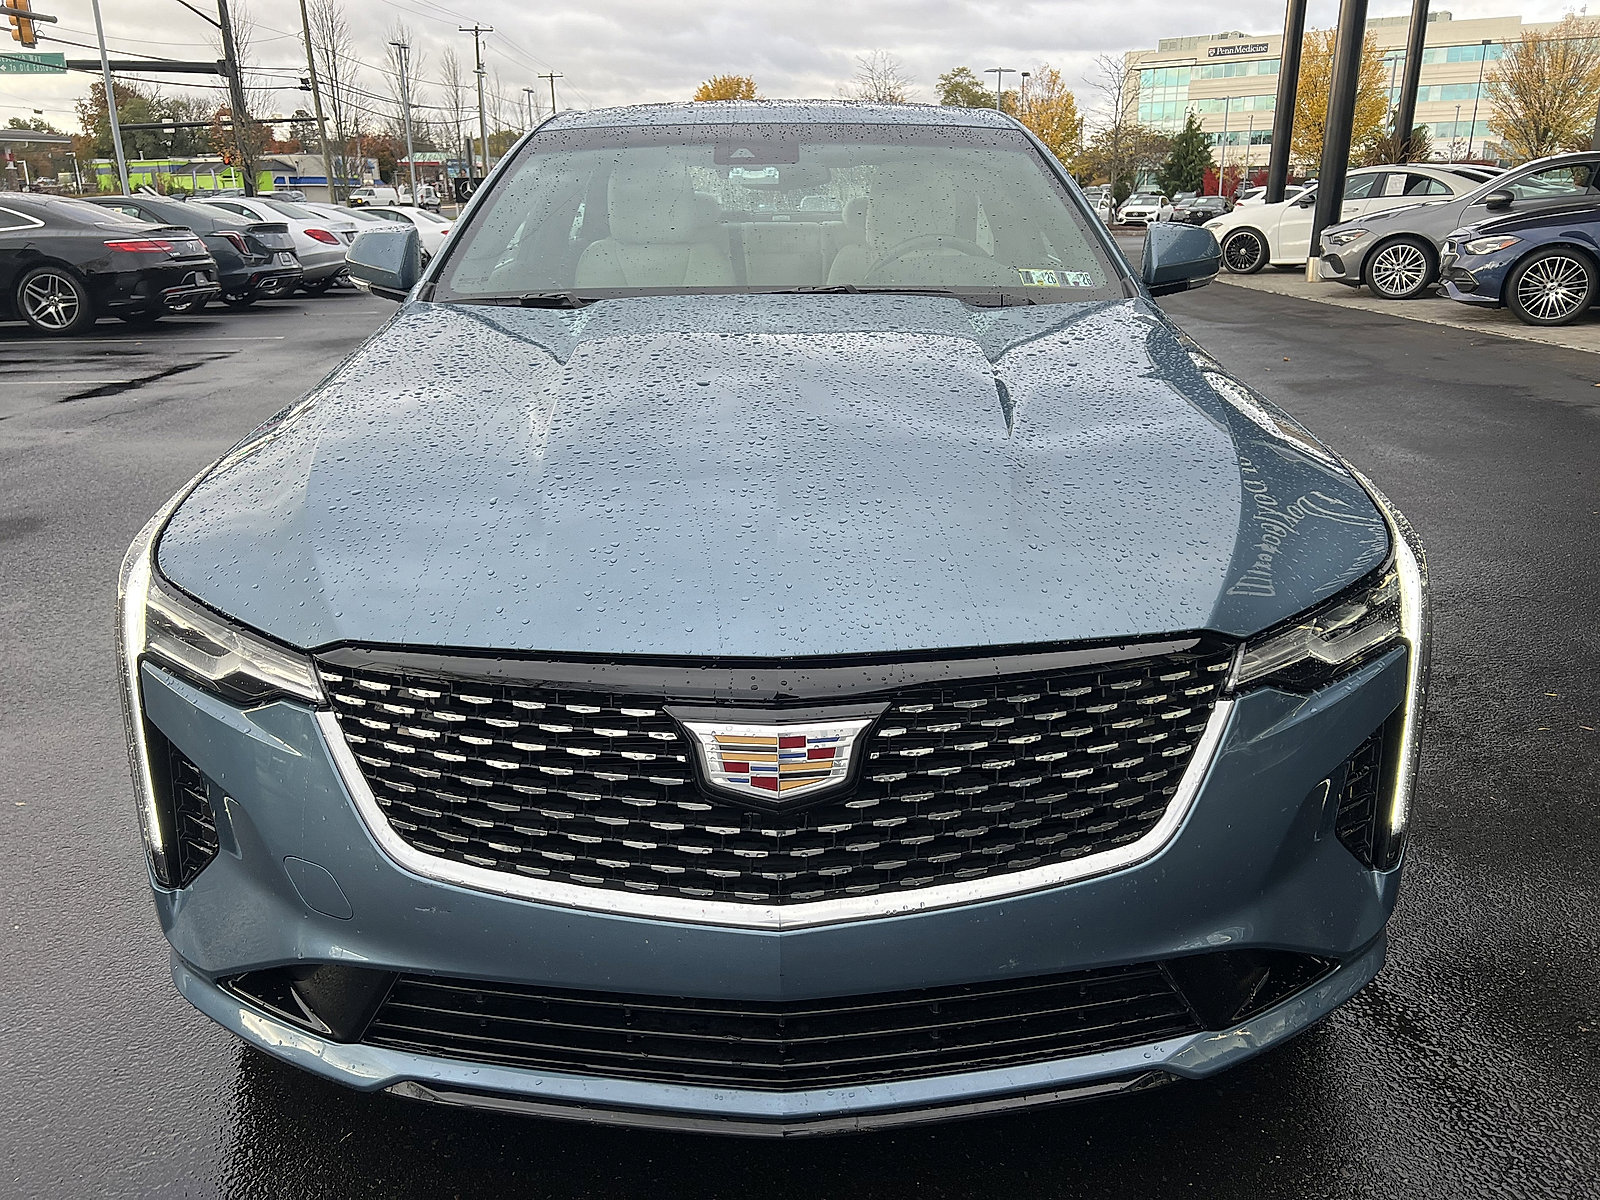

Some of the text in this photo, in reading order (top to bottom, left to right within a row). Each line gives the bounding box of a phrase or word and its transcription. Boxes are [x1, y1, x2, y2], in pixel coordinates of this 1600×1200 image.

[1217, 44, 1267, 55] Penn Medicine
[9, 64, 17, 72] To
[20, 64, 30, 72] Old
